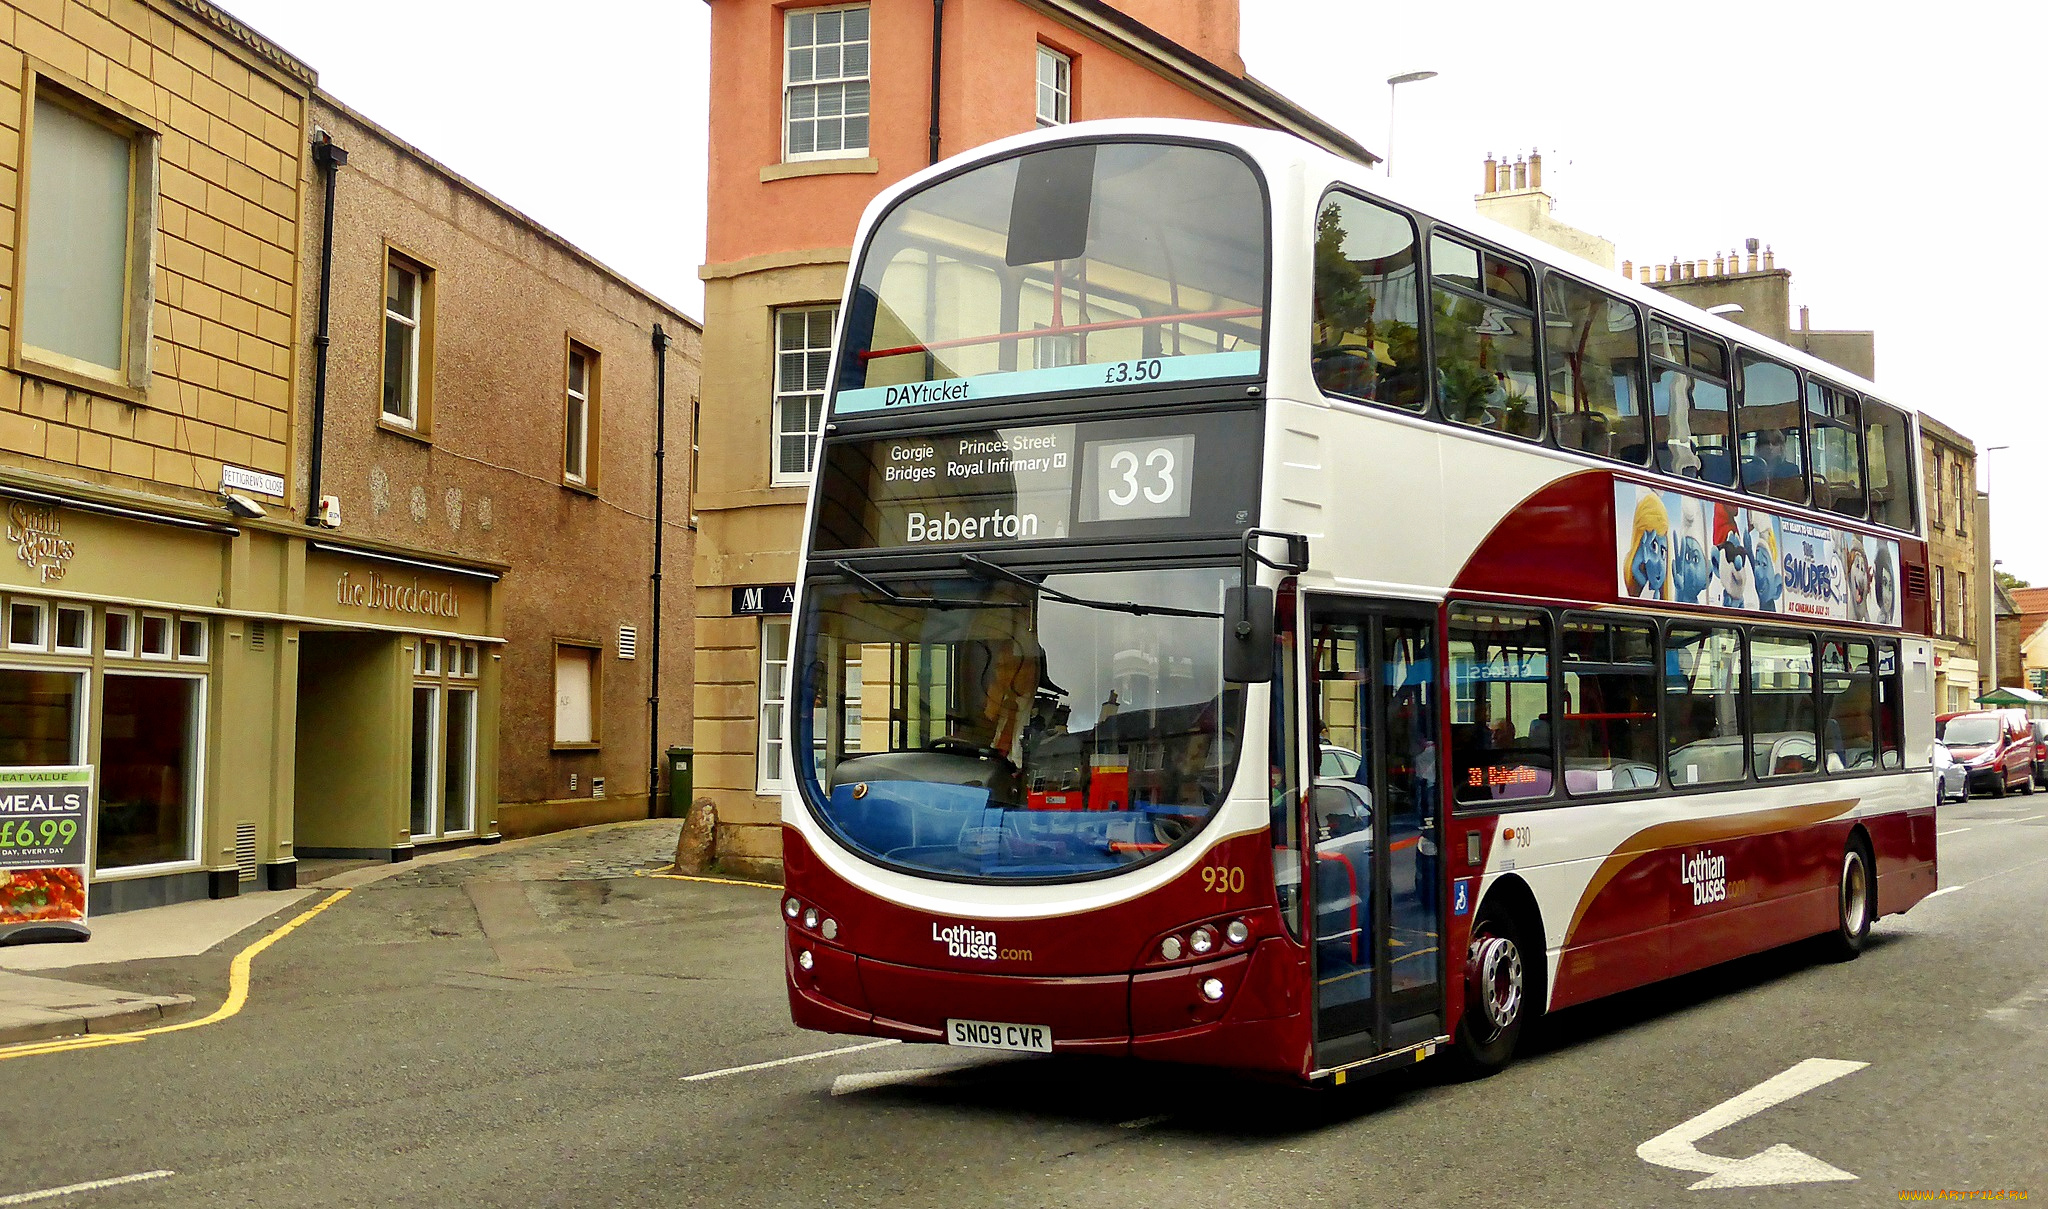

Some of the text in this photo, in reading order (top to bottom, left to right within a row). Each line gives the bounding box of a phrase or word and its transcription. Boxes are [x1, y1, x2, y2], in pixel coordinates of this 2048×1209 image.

[885, 359, 1162, 407] DAYticket £3.50
[891, 433, 1057, 462] Gorgie Princes Street
[224, 469, 283, 493] PETTIGREW'S CLOSE
[885, 465, 936, 482] Bridges
[946, 458, 984, 480] Royal
[987, 456, 1051, 474] Infirmary
[1108, 447, 1176, 506] 33
[907, 509, 1038, 542] Baberton
[1784, 553, 1831, 598] SMURFS
[337, 571, 459, 618] the Buccleuch
[1789, 602, 1795, 611] AT
[1795, 602, 1815, 614] CINEMAS
[1815, 604, 1825, 615] JULY
[0, 773, 68, 782] EAT VALUE
[1467, 765, 1536, 786] 33 Baberton
[0, 794, 81, 812] MEALS
[0, 818, 77, 848] £6.99
[1516, 826, 1531, 848] 930
[1201, 866, 1245, 893] 930
[1681, 849, 1725, 884] Lothian
[932, 922, 997, 945] Lothian
[955, 1022, 1044, 1048] SN09 CVR
